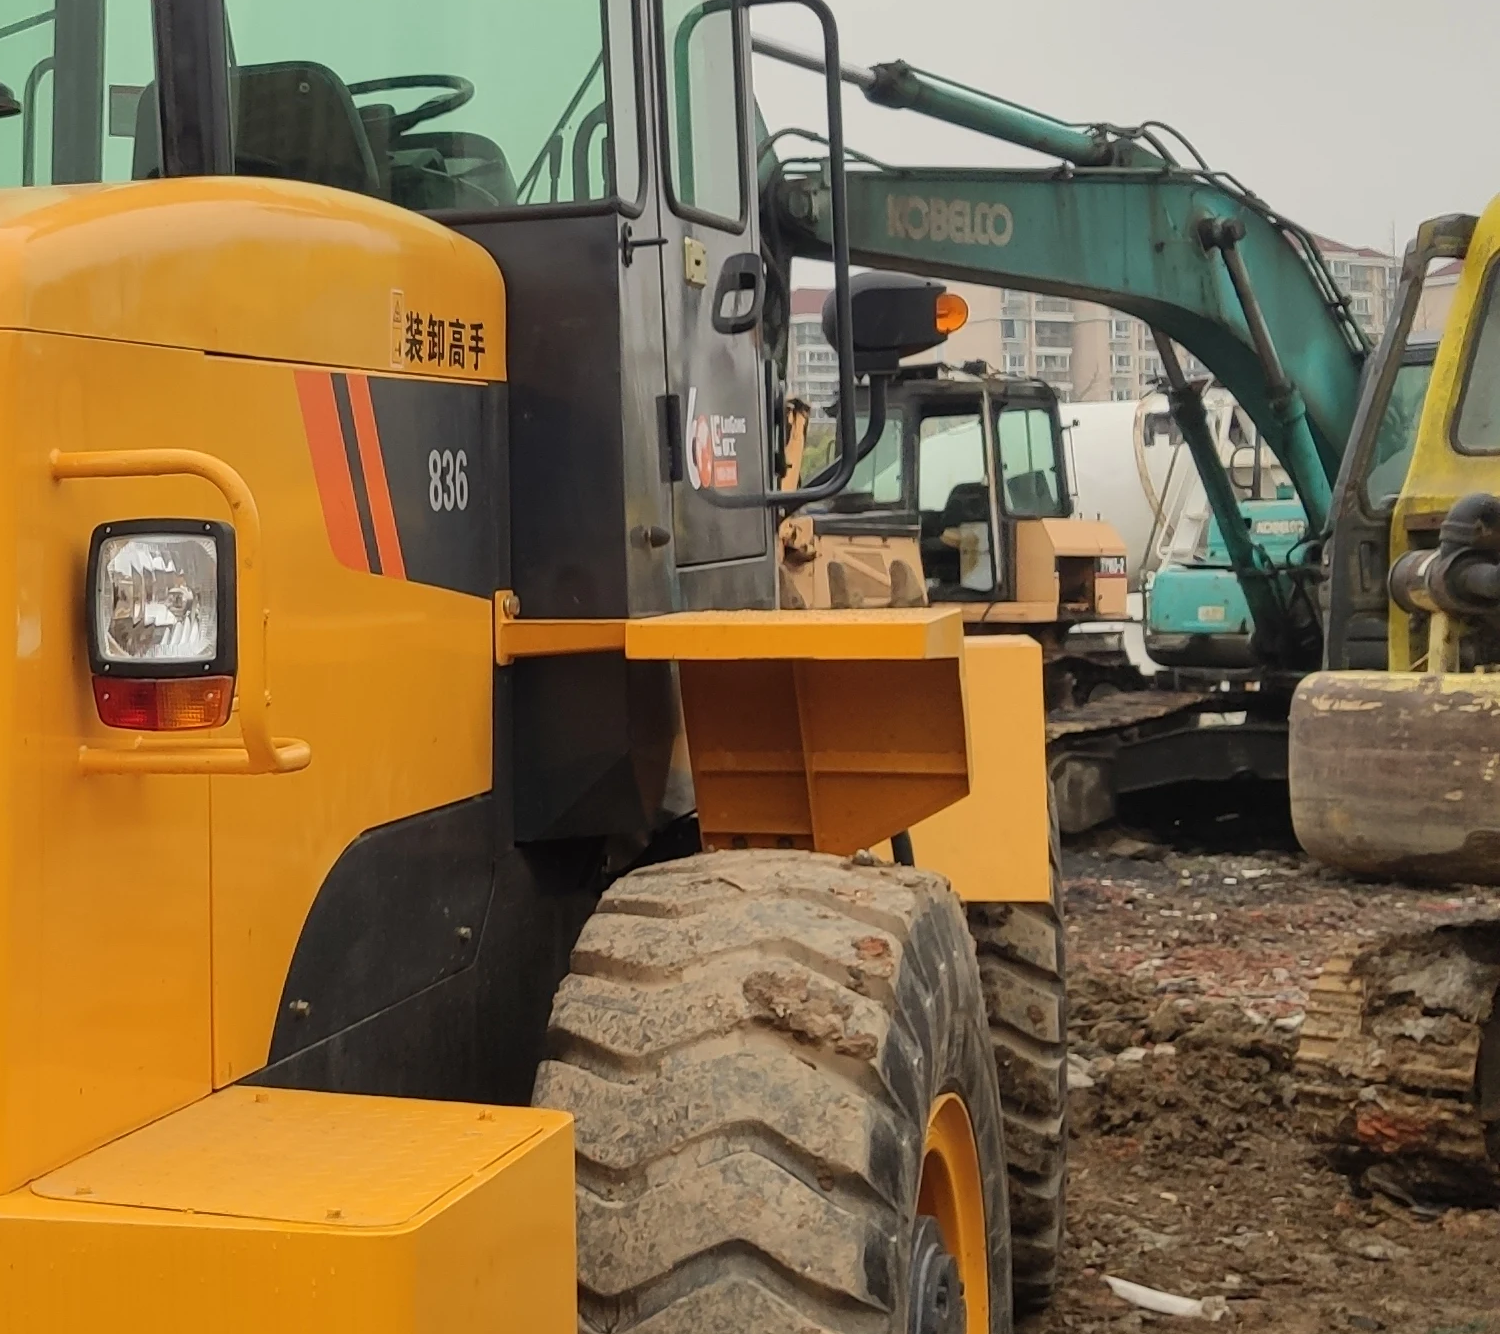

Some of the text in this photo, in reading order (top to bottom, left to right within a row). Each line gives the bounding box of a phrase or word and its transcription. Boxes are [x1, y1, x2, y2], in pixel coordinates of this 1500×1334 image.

[886, 194, 1014, 247] KOBELCO
[404, 310, 486, 371] 装卸高手
[428, 449, 469, 512] 836
